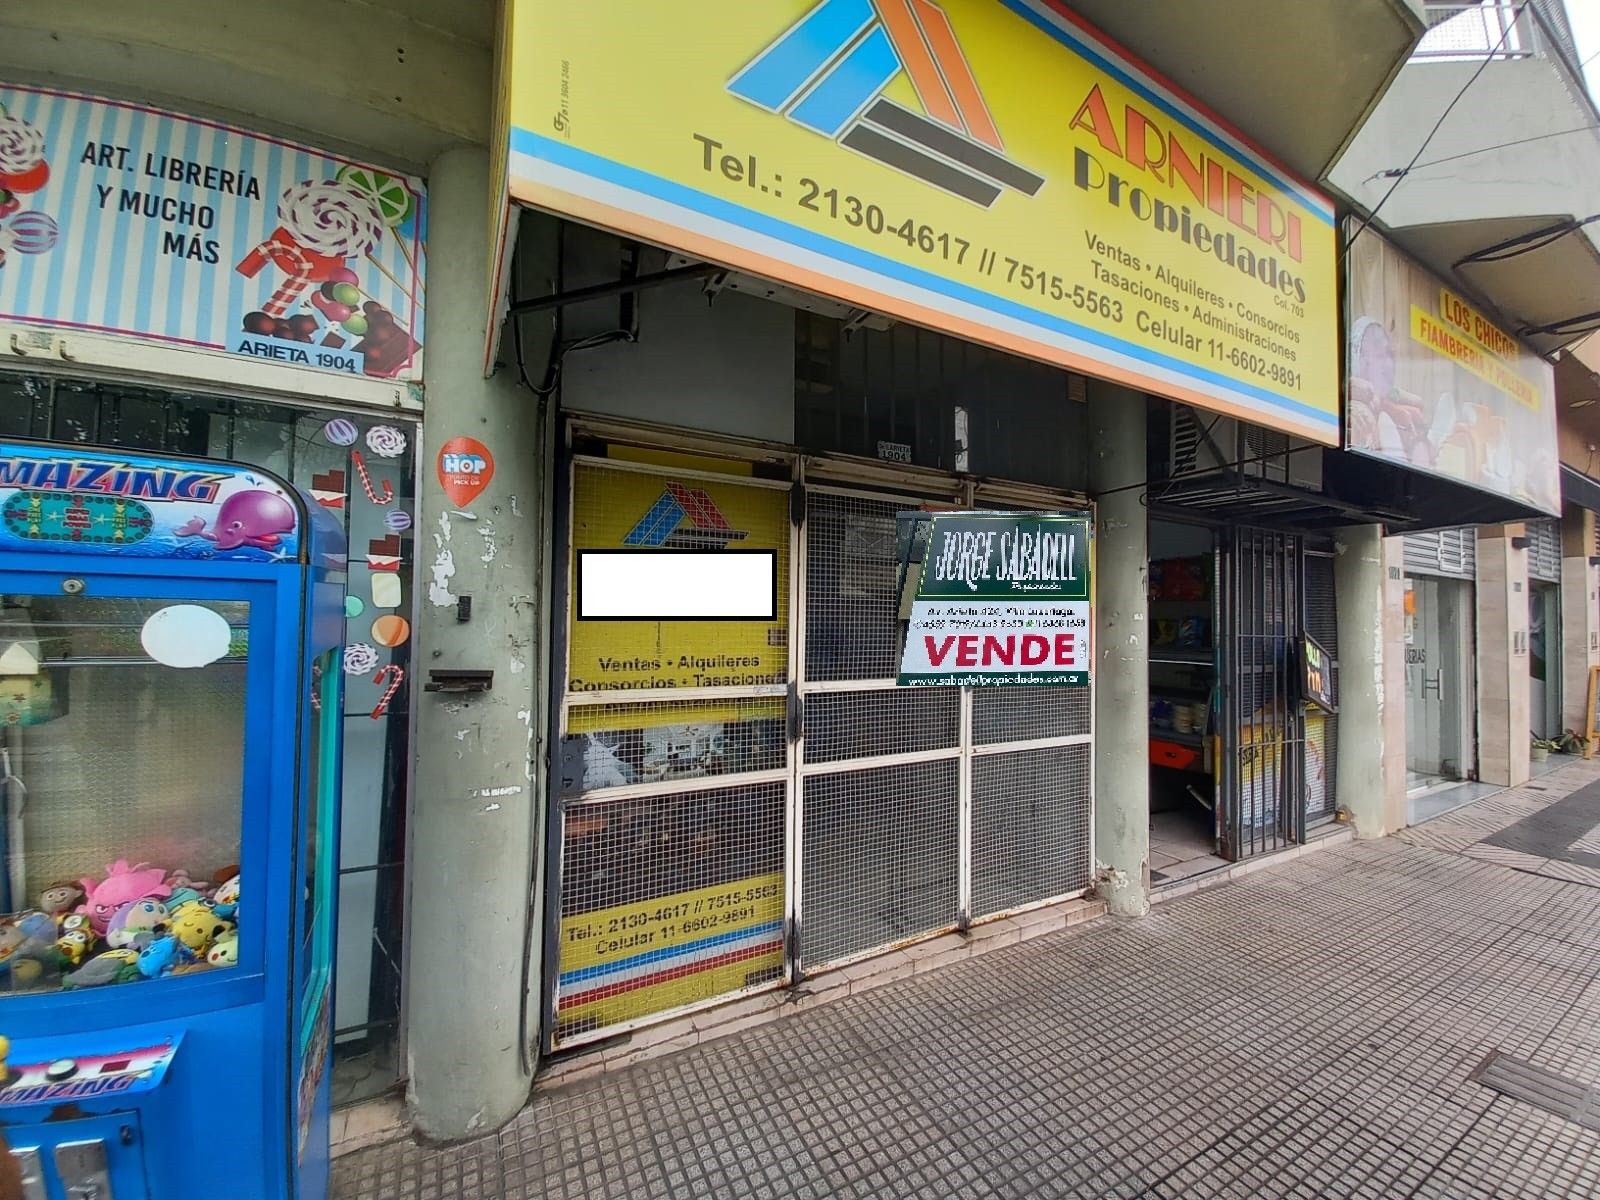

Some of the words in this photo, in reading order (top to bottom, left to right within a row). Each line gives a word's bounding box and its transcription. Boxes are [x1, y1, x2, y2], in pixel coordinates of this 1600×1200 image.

[80, 141, 133, 173] ART.
[144, 151, 261, 201] LIBRERÍA
[1069, 82, 1302, 264] ARNIERI
[97, 184, 114, 209] Y
[118, 191, 214, 230] MUCHO
[1074, 146, 1306, 304] Propiedades
[163, 230, 220, 264] MÁS
[693, 132, 783, 198] Tel.:
[798, 176, 970, 267] 2130-4617
[1004, 256, 1124, 324] 7515-5563
[1135, 310, 1203, 354] Celular
[1208, 339, 1302, 391] 11-6602-9891
[1085, 230, 1141, 271] Ventas
[1155, 265, 1224, 310] Alquileres
[1236, 302, 1300, 344] Consorcios
[1273, 294, 1289, 311] Col.
[1290, 302, 1304, 318] 703
[1091, 260, 1180, 313] Tasaciones
[1193, 304, 1298, 363] Administraciones
[1444, 293, 1470, 333] LOS
[237, 339, 310, 365] ARIETA
[316, 352, 356, 373] 1904
[443, 453, 487, 474] HOP
[569, 676, 676, 692] Consorcios
[599, 657, 661, 672] Ventas
[677, 655, 760, 672] Alquileres
[568, 925, 603, 942] Tel.:
[609, 903, 690, 934] 2130-4617
[708, 884, 778, 910] 7515-5563
[596, 931, 655, 955] Celular
